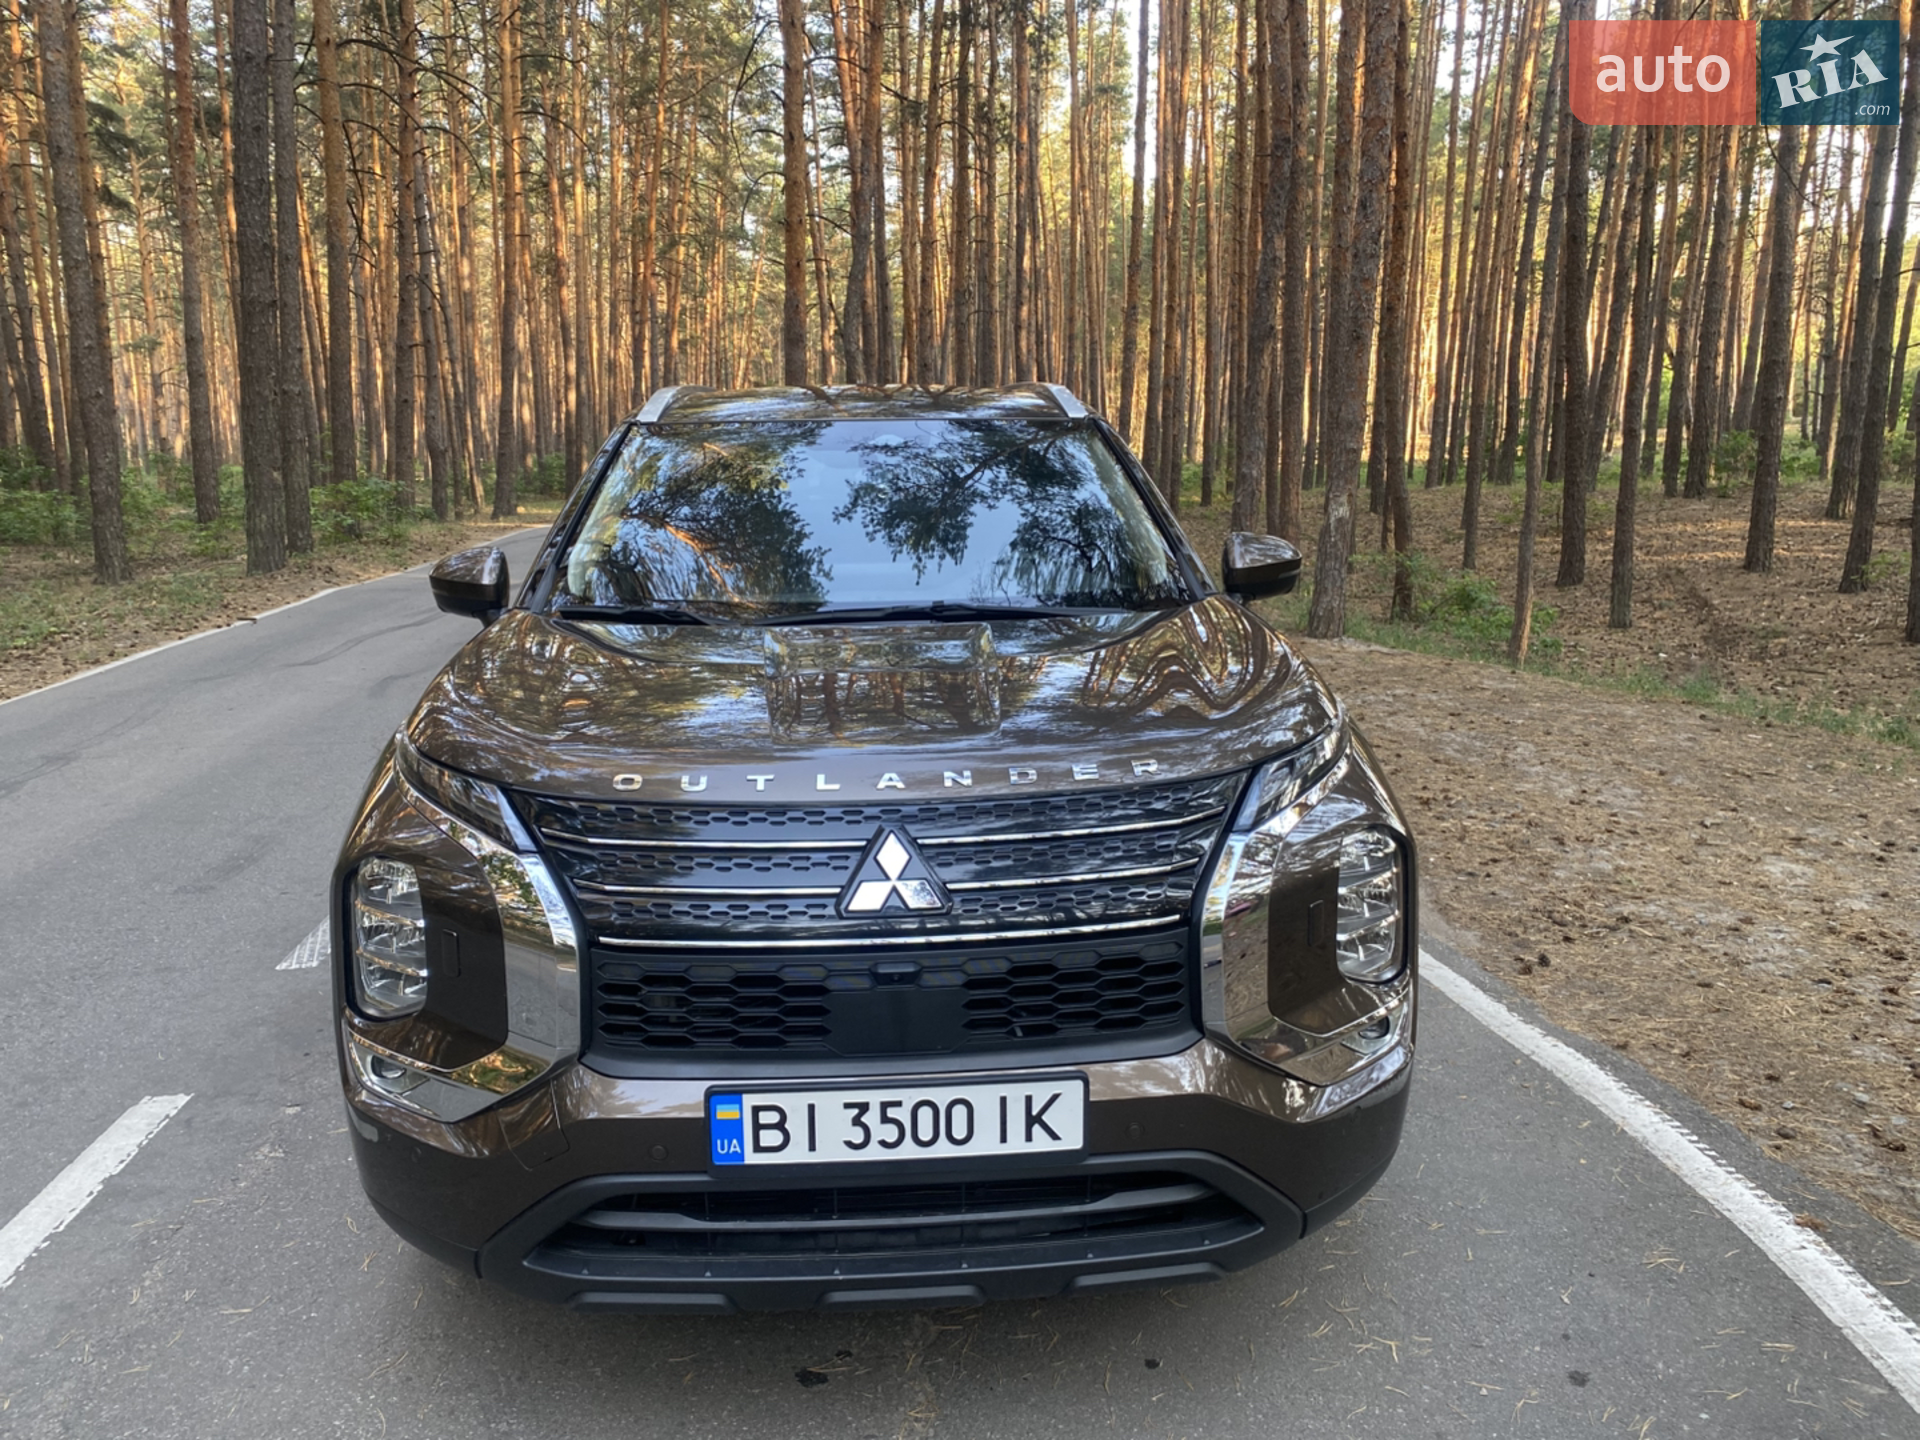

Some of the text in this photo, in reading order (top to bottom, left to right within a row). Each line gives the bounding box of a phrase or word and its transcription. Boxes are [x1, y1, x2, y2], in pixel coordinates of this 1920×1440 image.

[612, 758, 1161, 792] OUTLANDER
[750, 1092, 1063, 1154] BI 3500 IK
[716, 1139, 742, 1155] UA
